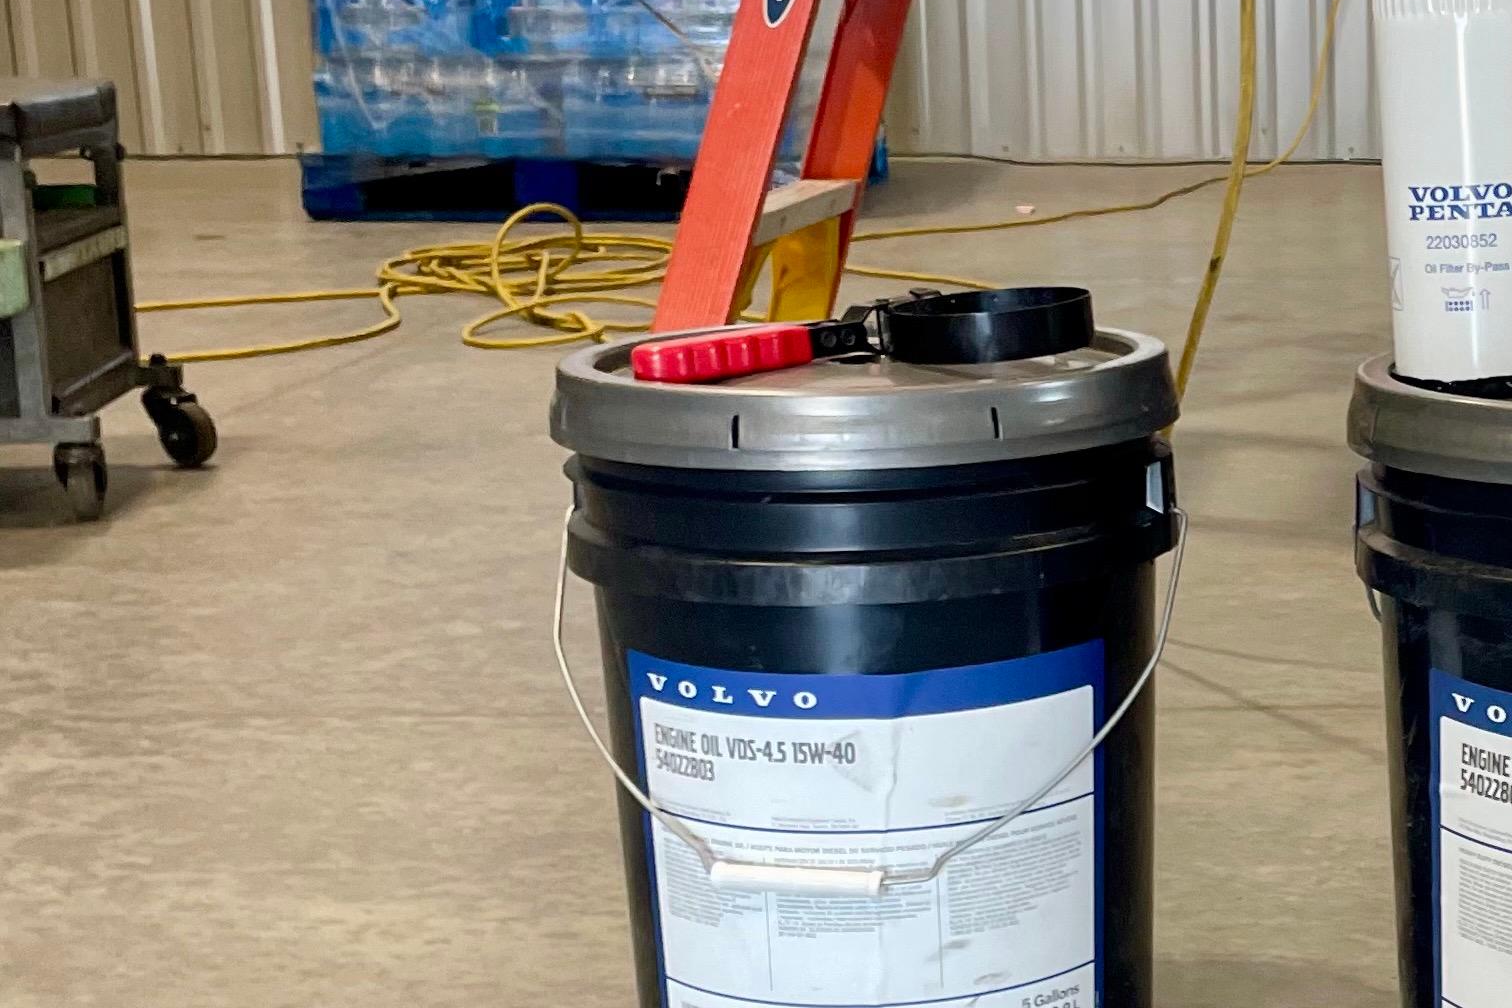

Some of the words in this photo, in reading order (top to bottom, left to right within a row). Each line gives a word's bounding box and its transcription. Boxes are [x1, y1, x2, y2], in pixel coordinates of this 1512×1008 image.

[1426, 233, 1498, 250] 22030852
[1424, 263, 1437, 273] Oil
[1439, 263, 1464, 273] Filter
[1466, 261, 1510, 274] By-Pass
[646, 672, 818, 710] VOLVO
[654, 722, 698, 754] ENGINE
[701, 733, 723, 758] OIL
[726, 737, 788, 763] VDS-4.5
[791, 741, 856, 765] 15W-40
[1461, 743, 1511, 778] ENGINE
[655, 748, 716, 782] 54022803
[1021, 997, 1032, 1008] 5
[1034, 983, 1081, 1007] Gallons
